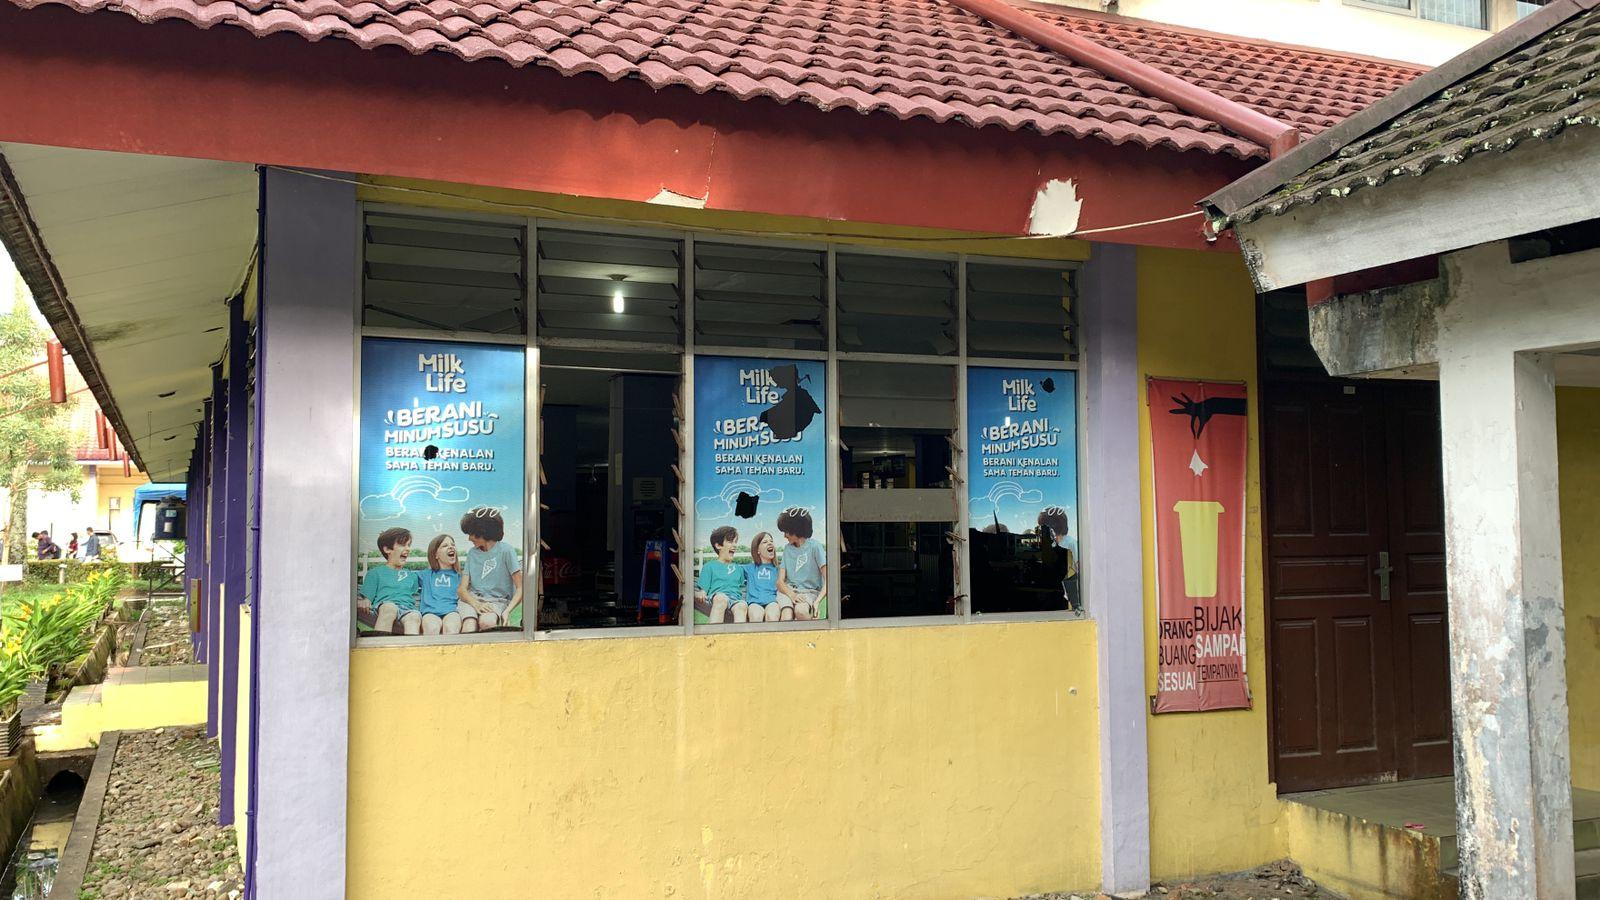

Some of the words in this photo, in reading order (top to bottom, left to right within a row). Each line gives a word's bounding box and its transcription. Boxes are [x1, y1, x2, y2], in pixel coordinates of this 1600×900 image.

[419, 353, 465, 373] Milk
[426, 373, 467, 393] Life
[740, 369, 777, 387] Milk
[746, 387, 780, 404] Life
[1002, 379, 1035, 395] Milk
[1008, 395, 1037, 412] Life
[397, 400, 483, 427] BERANI
[990, 418, 1048, 441] BERANI
[386, 461, 419, 471] SAMA
[424, 461, 458, 471] TEMAN
[463, 462, 495, 472] BARU.
[715, 453, 753, 463] BERANI
[755, 454, 803, 465] KENALAN
[983, 457, 1015, 466] BERANI
[1017, 458, 1058, 468] KENALAN
[715, 465, 742, 475] SAMA
[745, 466, 775, 475] TEMAN
[777, 466, 805, 475] BARU.
[983, 469, 1006, 477] SAMA
[1008, 469, 1035, 477] TEMAN
[1194, 606, 1242, 632] BIJAK
[1158, 671, 1196, 692] SESUAI
[1196, 664, 1239, 681] TEMPATNYA
